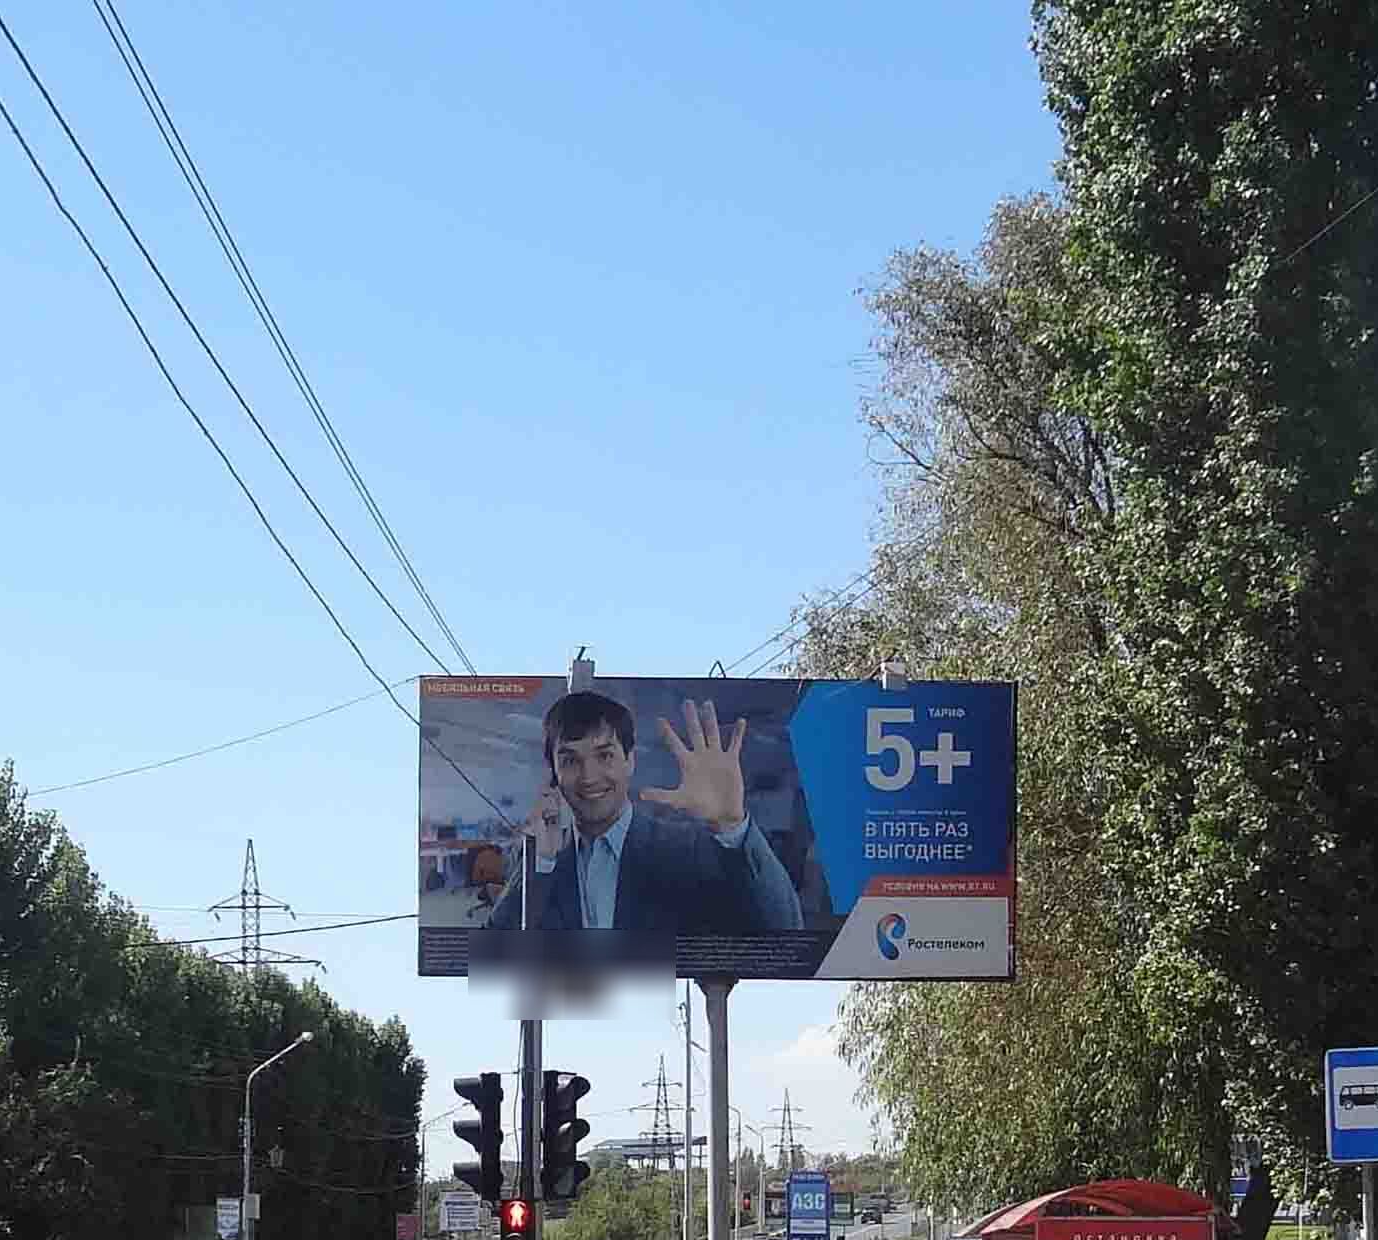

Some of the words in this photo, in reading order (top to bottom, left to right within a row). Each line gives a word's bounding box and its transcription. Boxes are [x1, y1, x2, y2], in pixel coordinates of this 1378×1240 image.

[928, 707, 966, 718] ТАРИФ
[865, 822, 878, 837] В
[883, 821, 930, 837] ПЯТЬ
[935, 821, 969, 837] РАЗ
[907, 937, 985, 951] Ростелеком
[792, 1192, 826, 1210] АЗС
